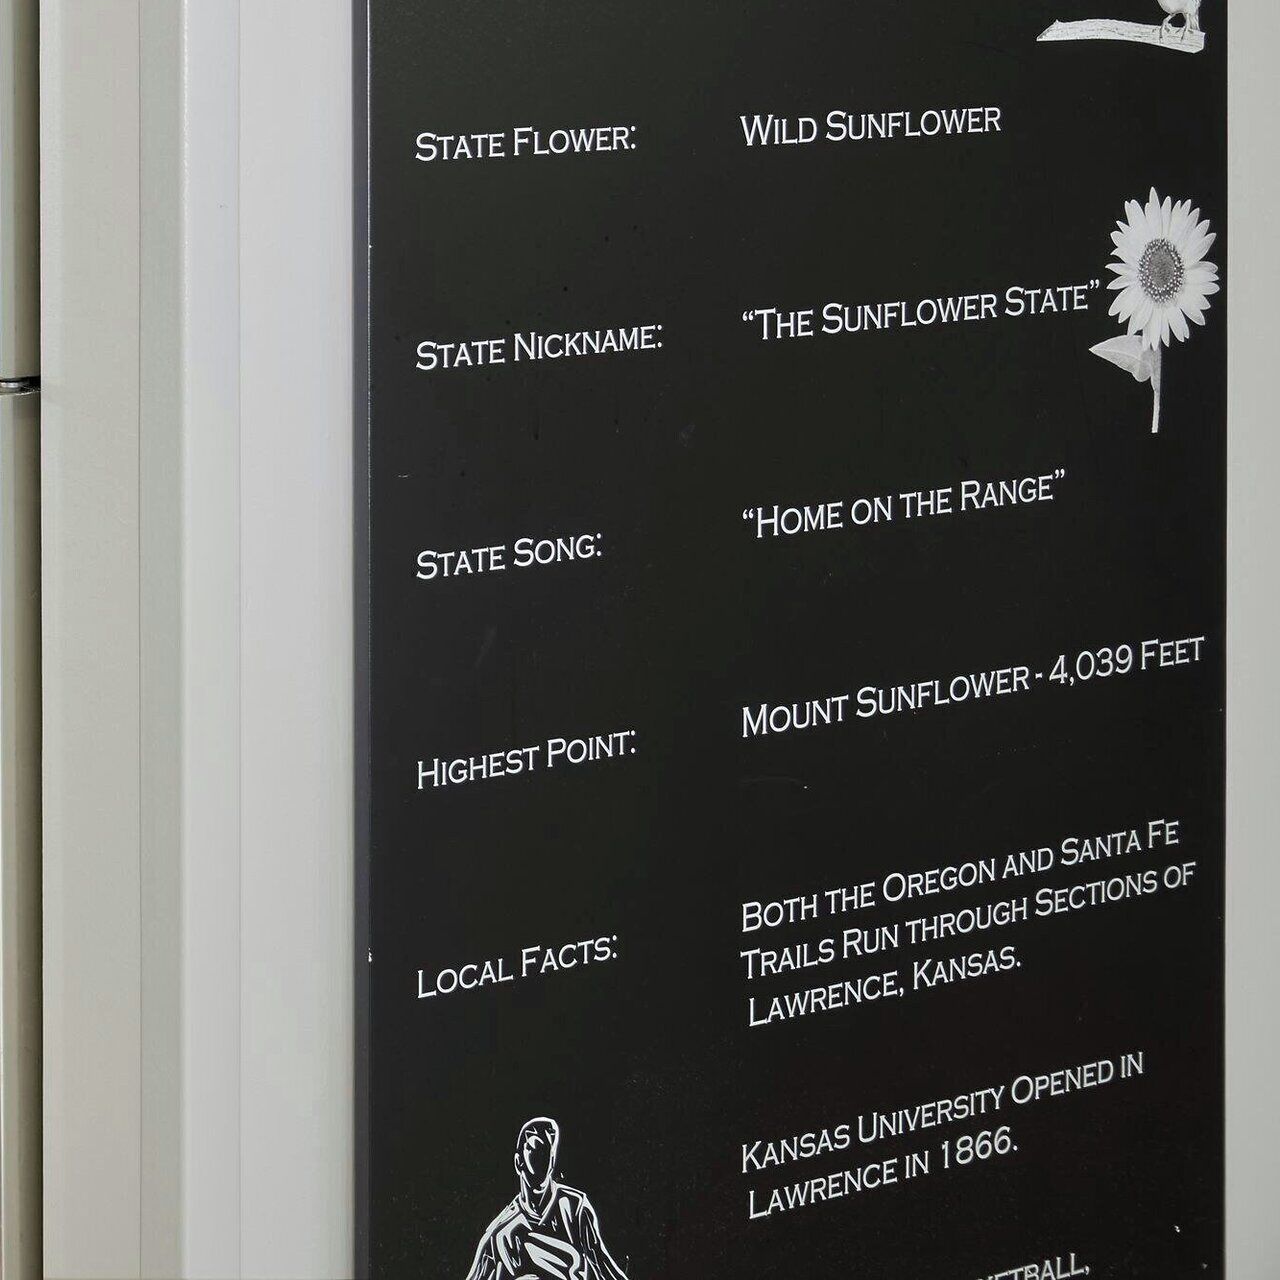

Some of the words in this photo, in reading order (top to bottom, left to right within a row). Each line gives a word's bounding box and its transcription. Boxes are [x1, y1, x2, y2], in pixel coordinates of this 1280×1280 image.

[415, 133, 506, 162] STATE
[514, 126, 637, 156] FLOWER:
[740, 114, 818, 147] WILD
[826, 107, 1002, 142] SUNFLOWER
[821, 292, 997, 334] SUNFLOWER
[416, 339, 506, 371] STATE
[514, 325, 663, 362] NICKNAME:
[851, 496, 892, 525] ON
[900, 487, 953, 519] THE
[416, 545, 506, 580] STATE
[514, 533, 602, 567] SONG:
[743, 695, 849, 738] MOUNT
[856, 666, 1030, 718] SUNFLOWER
[1049, 644, 1133, 687] 4,039
[1141, 636, 1205, 670] FEET
[418, 746, 540, 790] HIGHEST
[548, 730, 636, 768] POINT:
[741, 893, 818, 933] BOTH
[825, 881, 876, 918] THE
[883, 858, 995, 901] OREGON
[1002, 847, 1054, 880] AND
[1060, 830, 1142, 867] SANTA
[1148, 818, 1179, 849] FE
[740, 938, 835, 980] TRAILS
[842, 924, 899, 959] RUN
[906, 897, 1028, 944] THROUGH
[1035, 870, 1157, 918] SECTIONS
[1164, 861, 1197, 889] OF
[418, 958, 514, 999] LOCAL
[522, 935, 618, 978] FACTS:
[749, 970, 904, 1027] LAWRENCE,
[913, 946, 1022, 991] KANSAS.
[741, 1125, 851, 1174] KANSAS
[858, 1086, 1004, 1143] UNIVERSITY
[1011, 1059, 1114, 1105] OPENED
[1120, 1052, 1144, 1080] IN
[749, 1160, 898, 1220] LAWRENCE
[904, 1151, 930, 1179] IN
[941, 1125, 1018, 1169] 1866.
